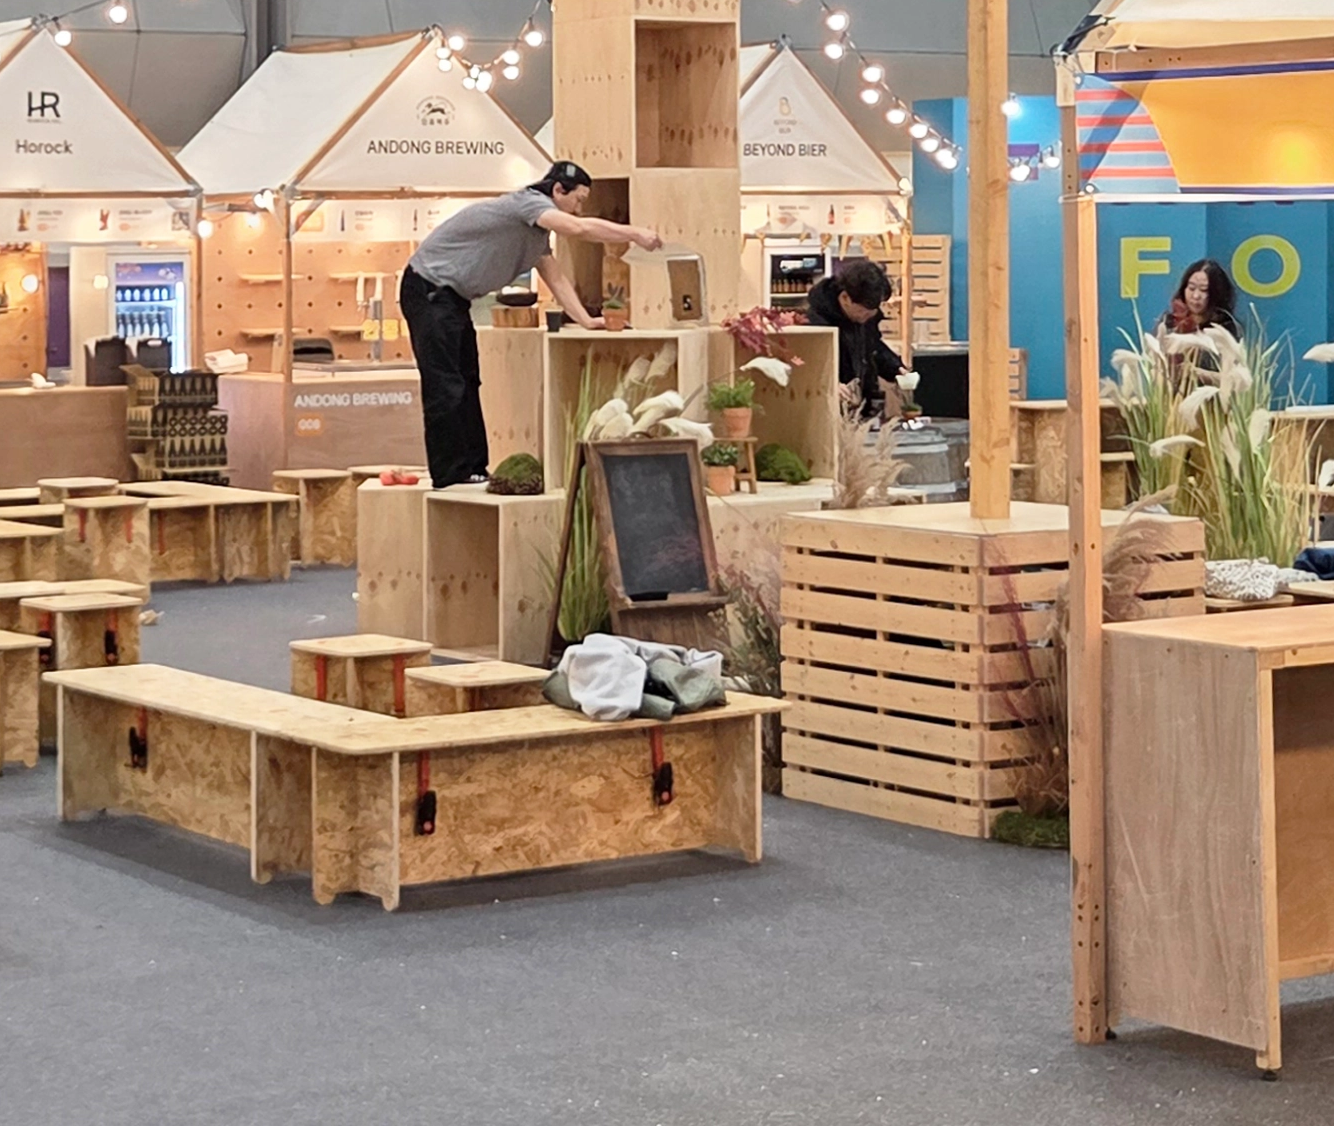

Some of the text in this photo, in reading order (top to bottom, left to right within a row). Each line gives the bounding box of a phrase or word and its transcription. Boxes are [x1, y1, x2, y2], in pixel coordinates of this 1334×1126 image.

[15, 139, 73, 154] Horock
[367, 139, 505, 156] ANDONG BREWING
[743, 143, 827, 157] BEYOND BIER
[294, 392, 412, 407] ANDONG BREWING
